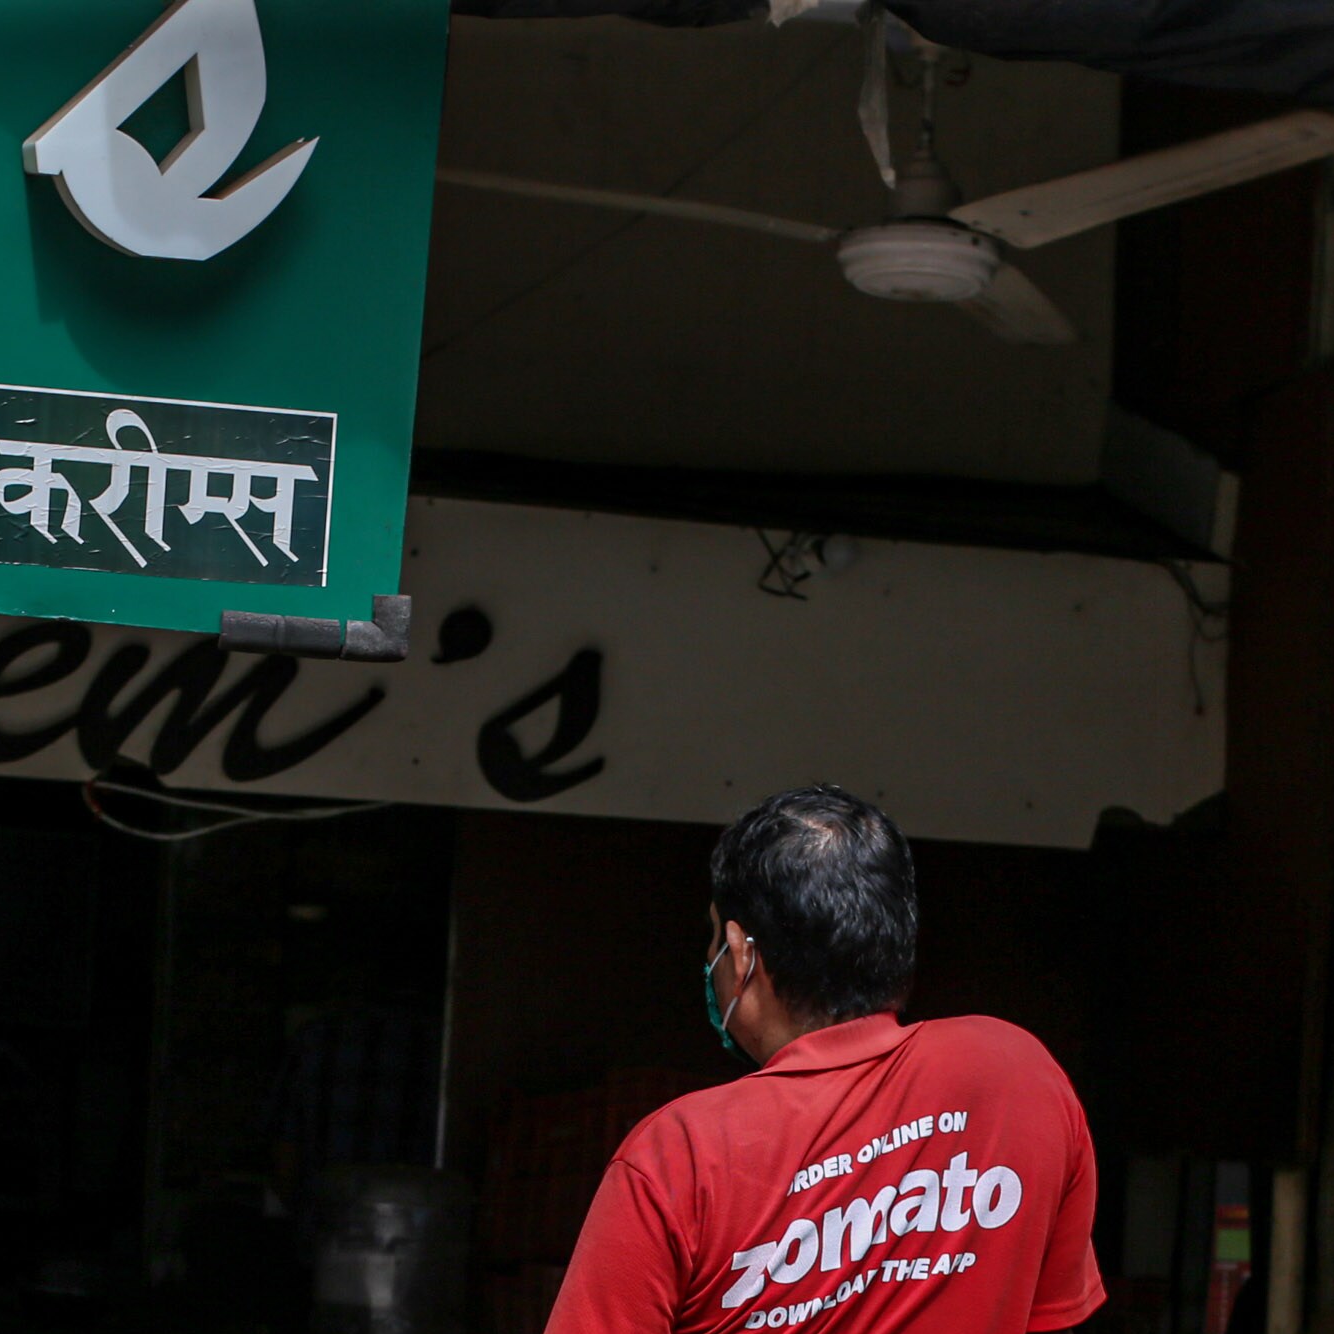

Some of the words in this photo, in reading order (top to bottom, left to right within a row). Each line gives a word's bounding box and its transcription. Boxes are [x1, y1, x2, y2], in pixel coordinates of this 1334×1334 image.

[787, 1154, 853, 1196] RDER
[856, 1115, 934, 1163] ONLINE
[938, 1112, 967, 1133] ON
[721, 1151, 1023, 1309] zomato
[881, 1258, 931, 1282] THE
